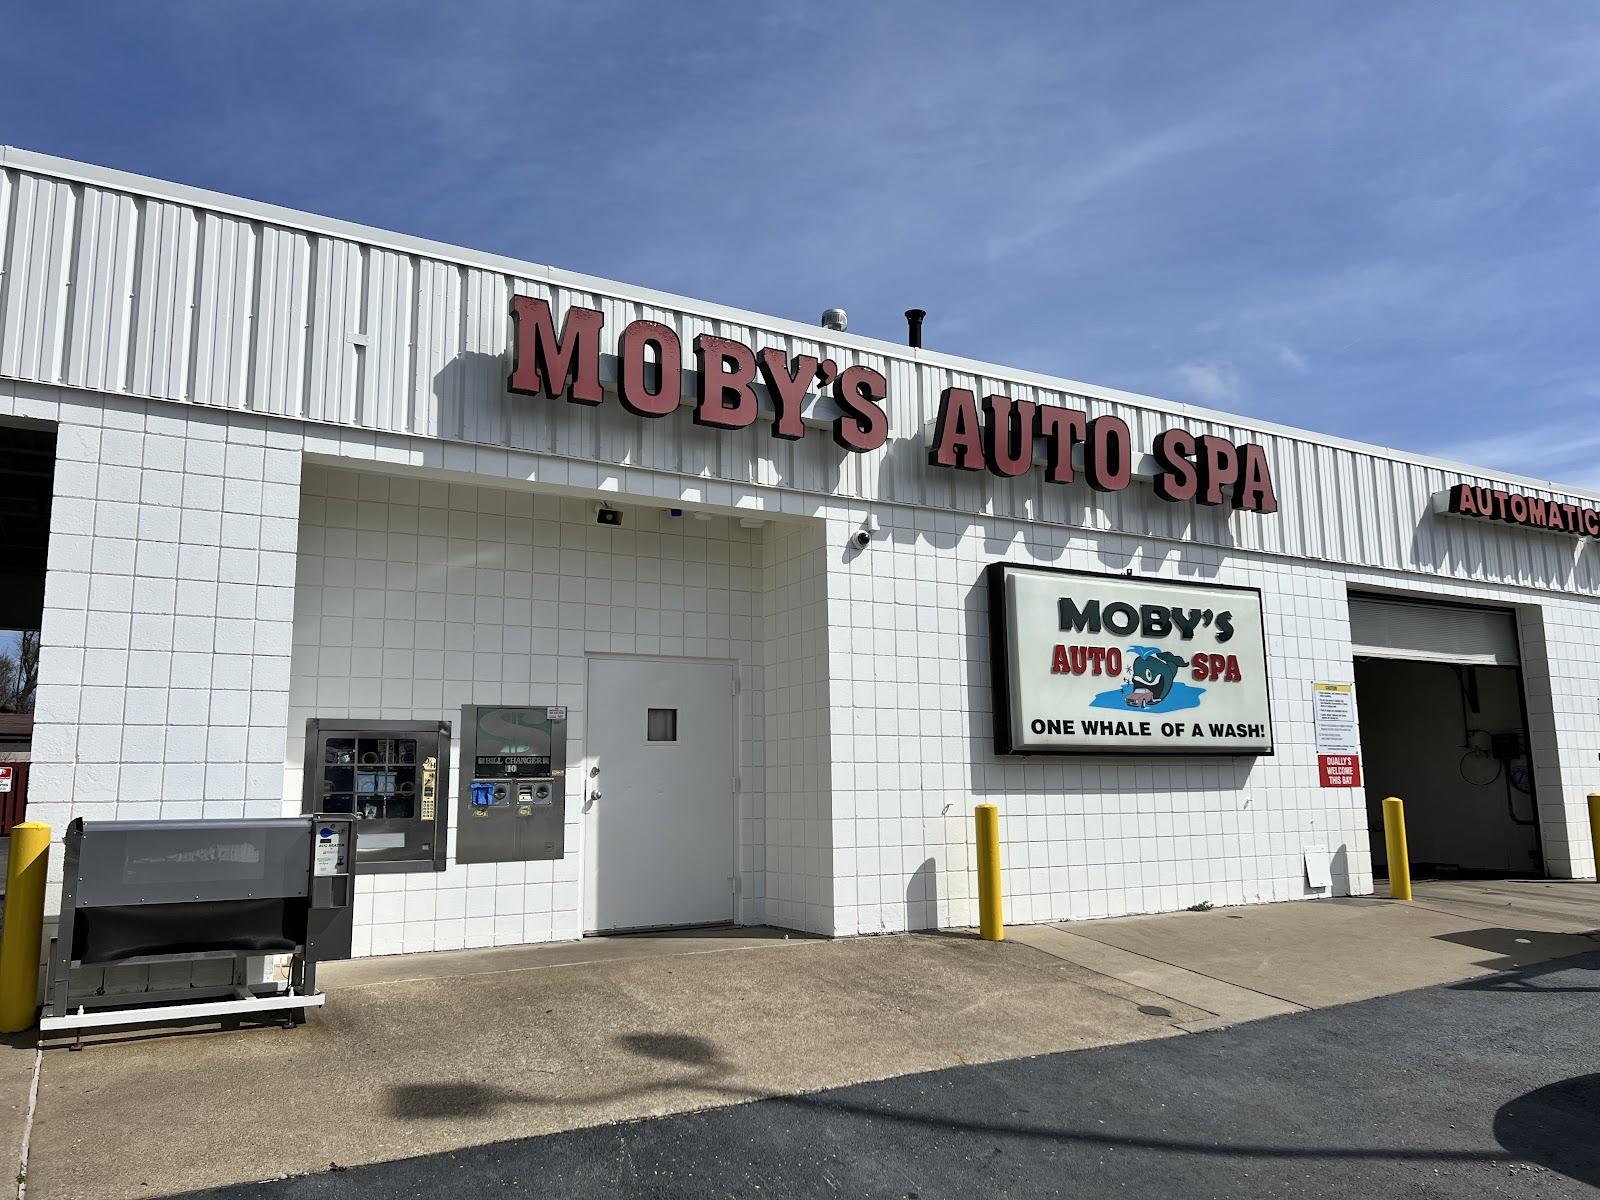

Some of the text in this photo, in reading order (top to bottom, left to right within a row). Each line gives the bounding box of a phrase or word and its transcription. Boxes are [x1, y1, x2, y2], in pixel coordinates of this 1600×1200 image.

[508, 294, 1277, 514] MOBY'S AUTO SPA
[1450, 484, 1600, 537] AUTOMATIC
[1057, 597, 1236, 644] MOBY'S
[1051, 644, 1242, 682] AUTO SPA
[1031, 718, 1265, 738] ONE WHALE OF A WASH!
[485, 757, 542, 765] BILL CHANGER
[1326, 766, 1354, 776] WELCOME
[1327, 757, 1352, 766] DUALLY'S
[1329, 776, 1353, 785] THIS BAY
